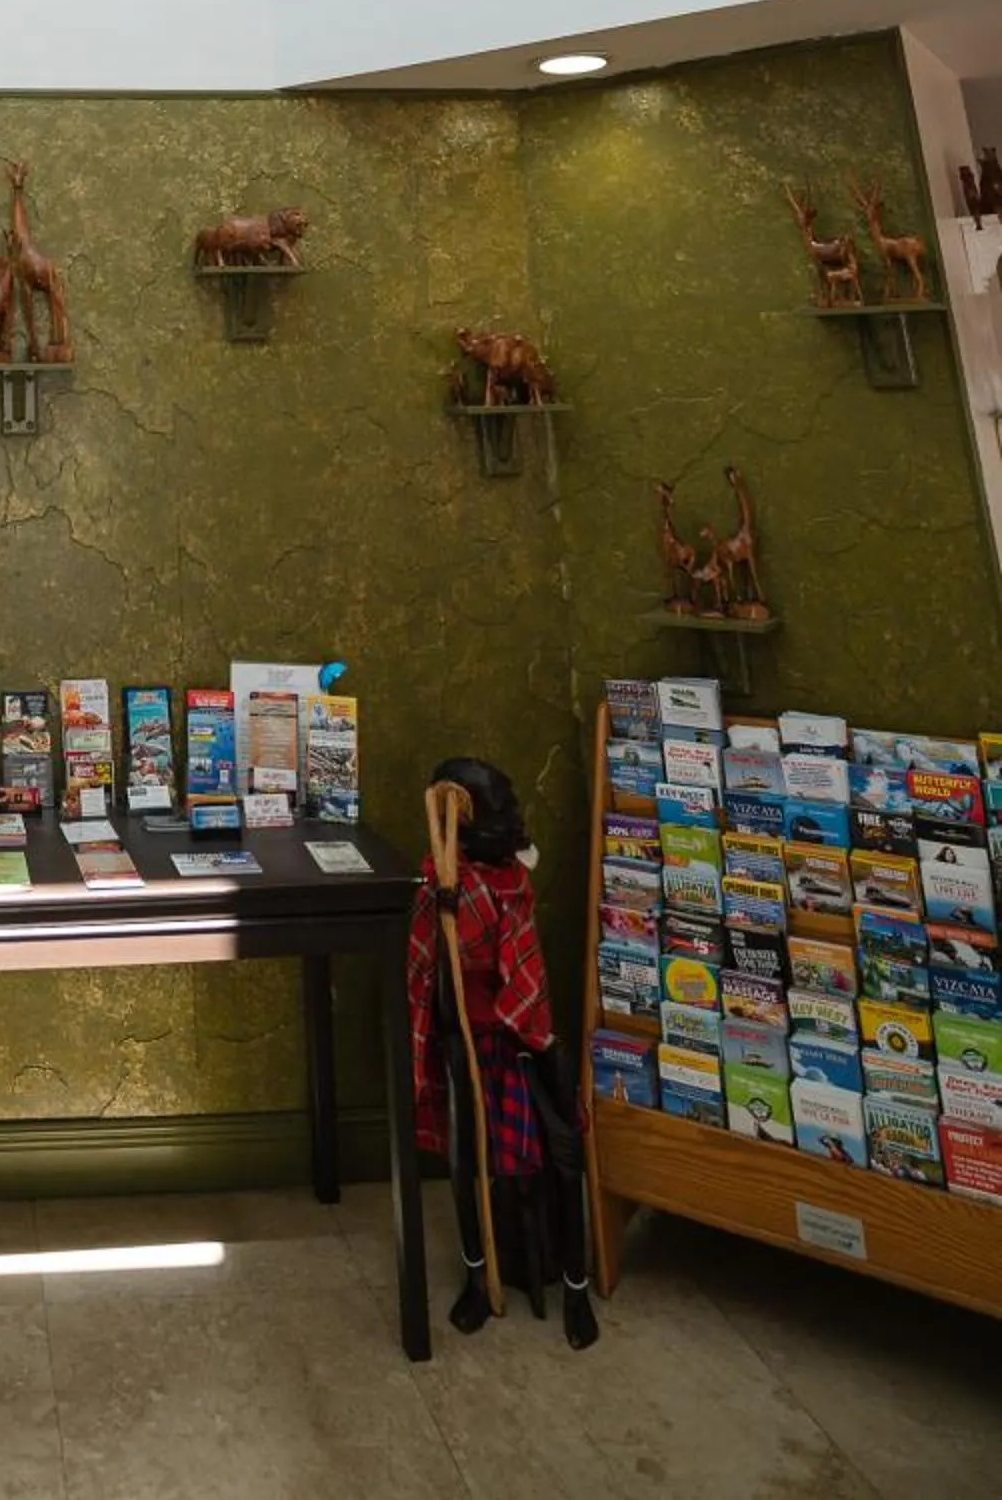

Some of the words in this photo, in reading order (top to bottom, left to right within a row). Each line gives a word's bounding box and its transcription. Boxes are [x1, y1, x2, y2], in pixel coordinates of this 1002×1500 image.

[914, 776, 972, 789] BUTTERFLY
[914, 786, 951, 797] WORLD
[733, 803, 783, 817] VIZCAYA
[723, 984, 778, 1003] MASSAGE
[934, 975, 997, 998] VIZCAYA
